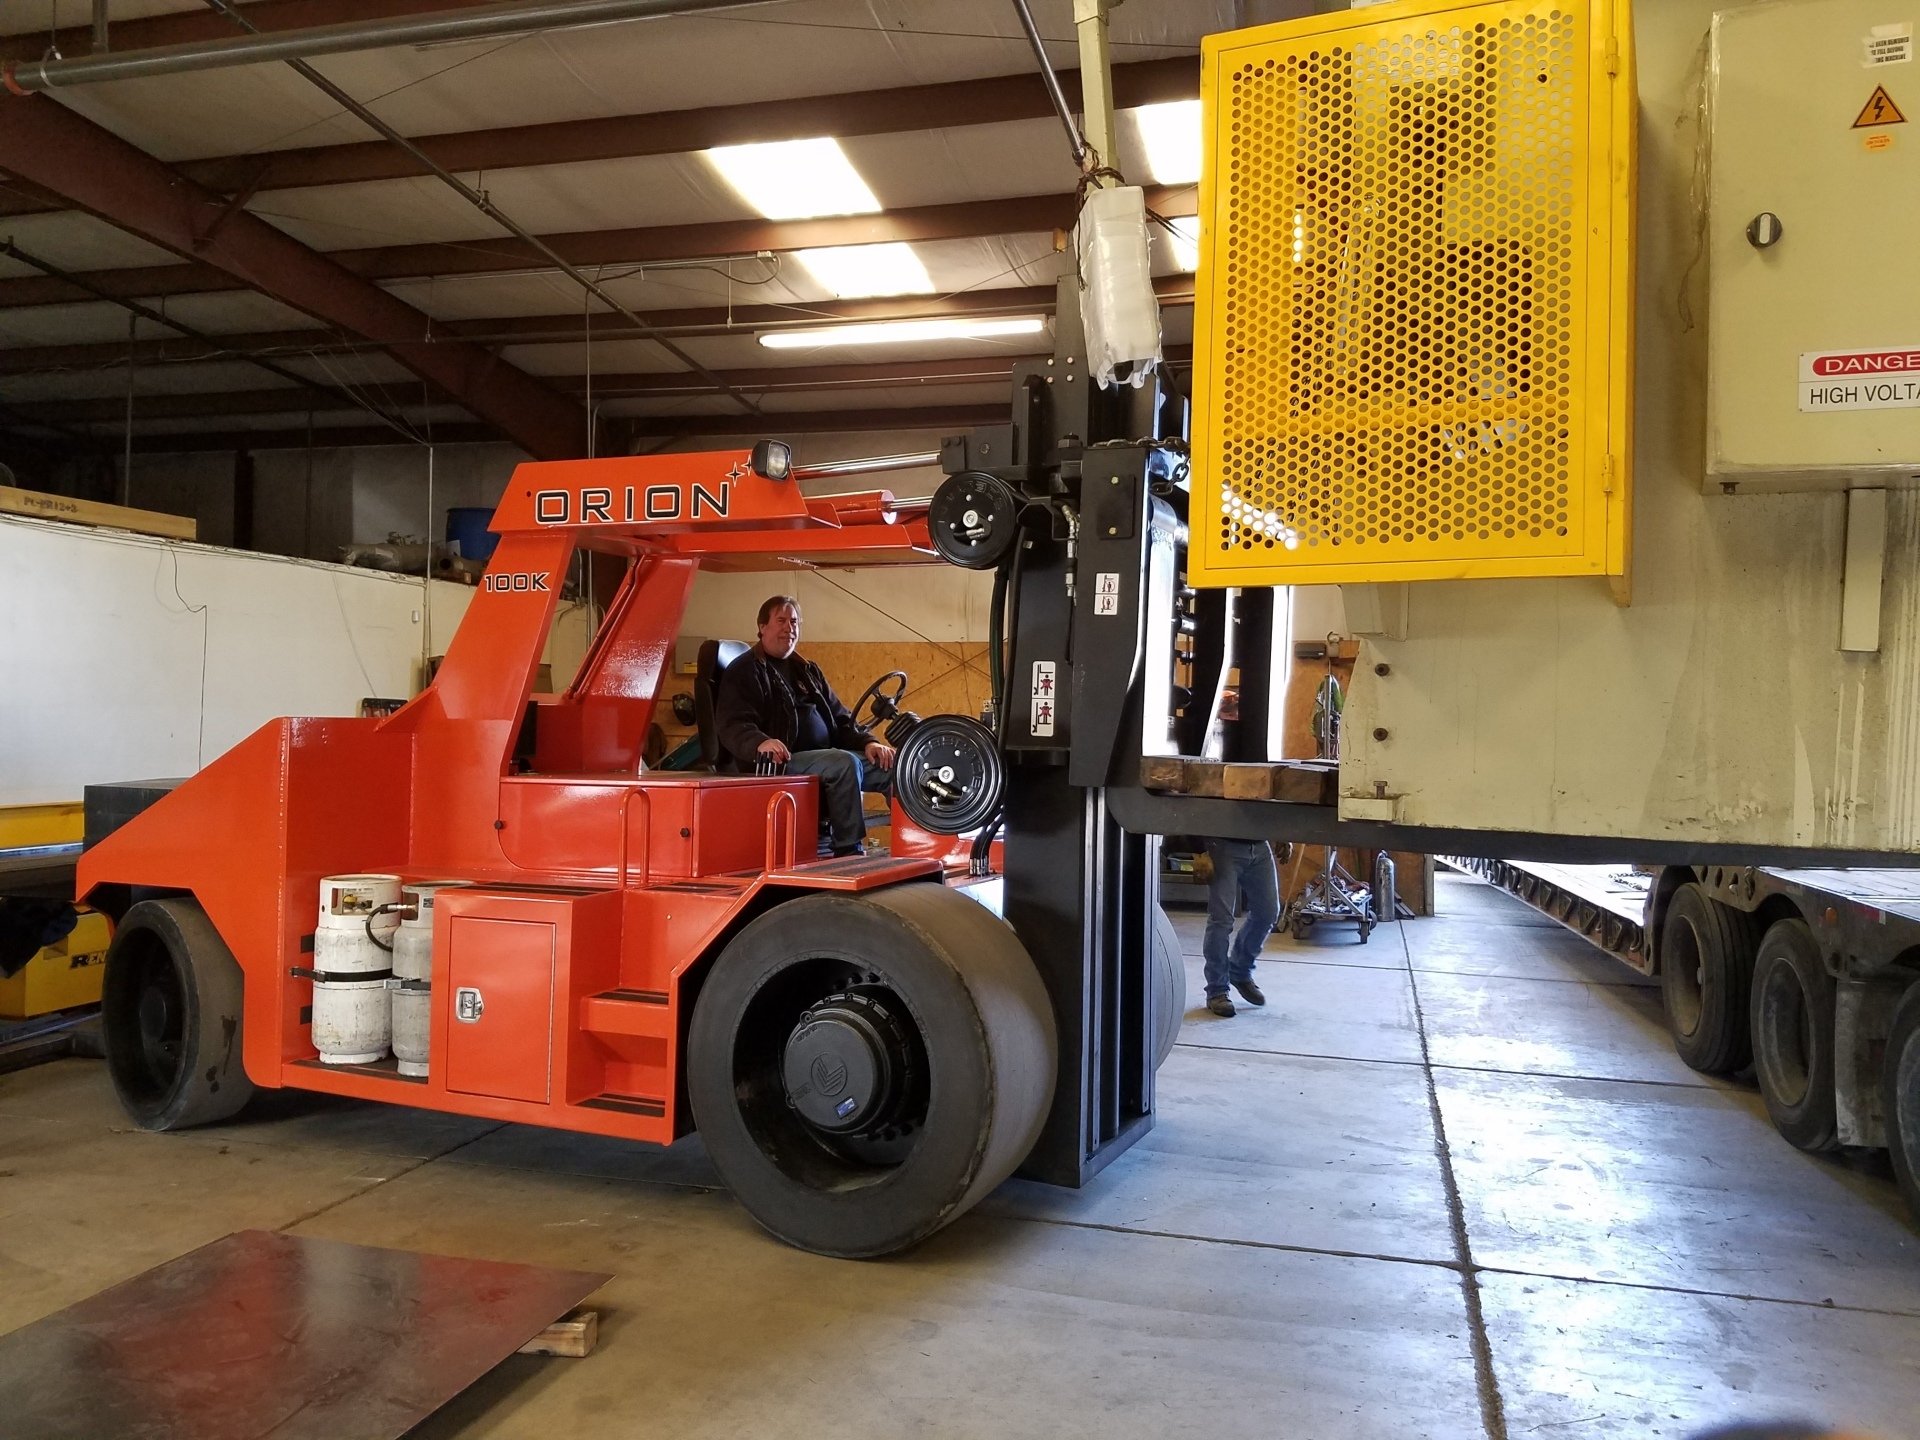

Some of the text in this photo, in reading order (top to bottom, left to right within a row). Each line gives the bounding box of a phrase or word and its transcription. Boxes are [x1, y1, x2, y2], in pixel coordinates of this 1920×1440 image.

[1810, 383, 1920, 405] HIGH VOLT
[535, 481, 730, 524] ORION
[484, 571, 550, 592] 100K
